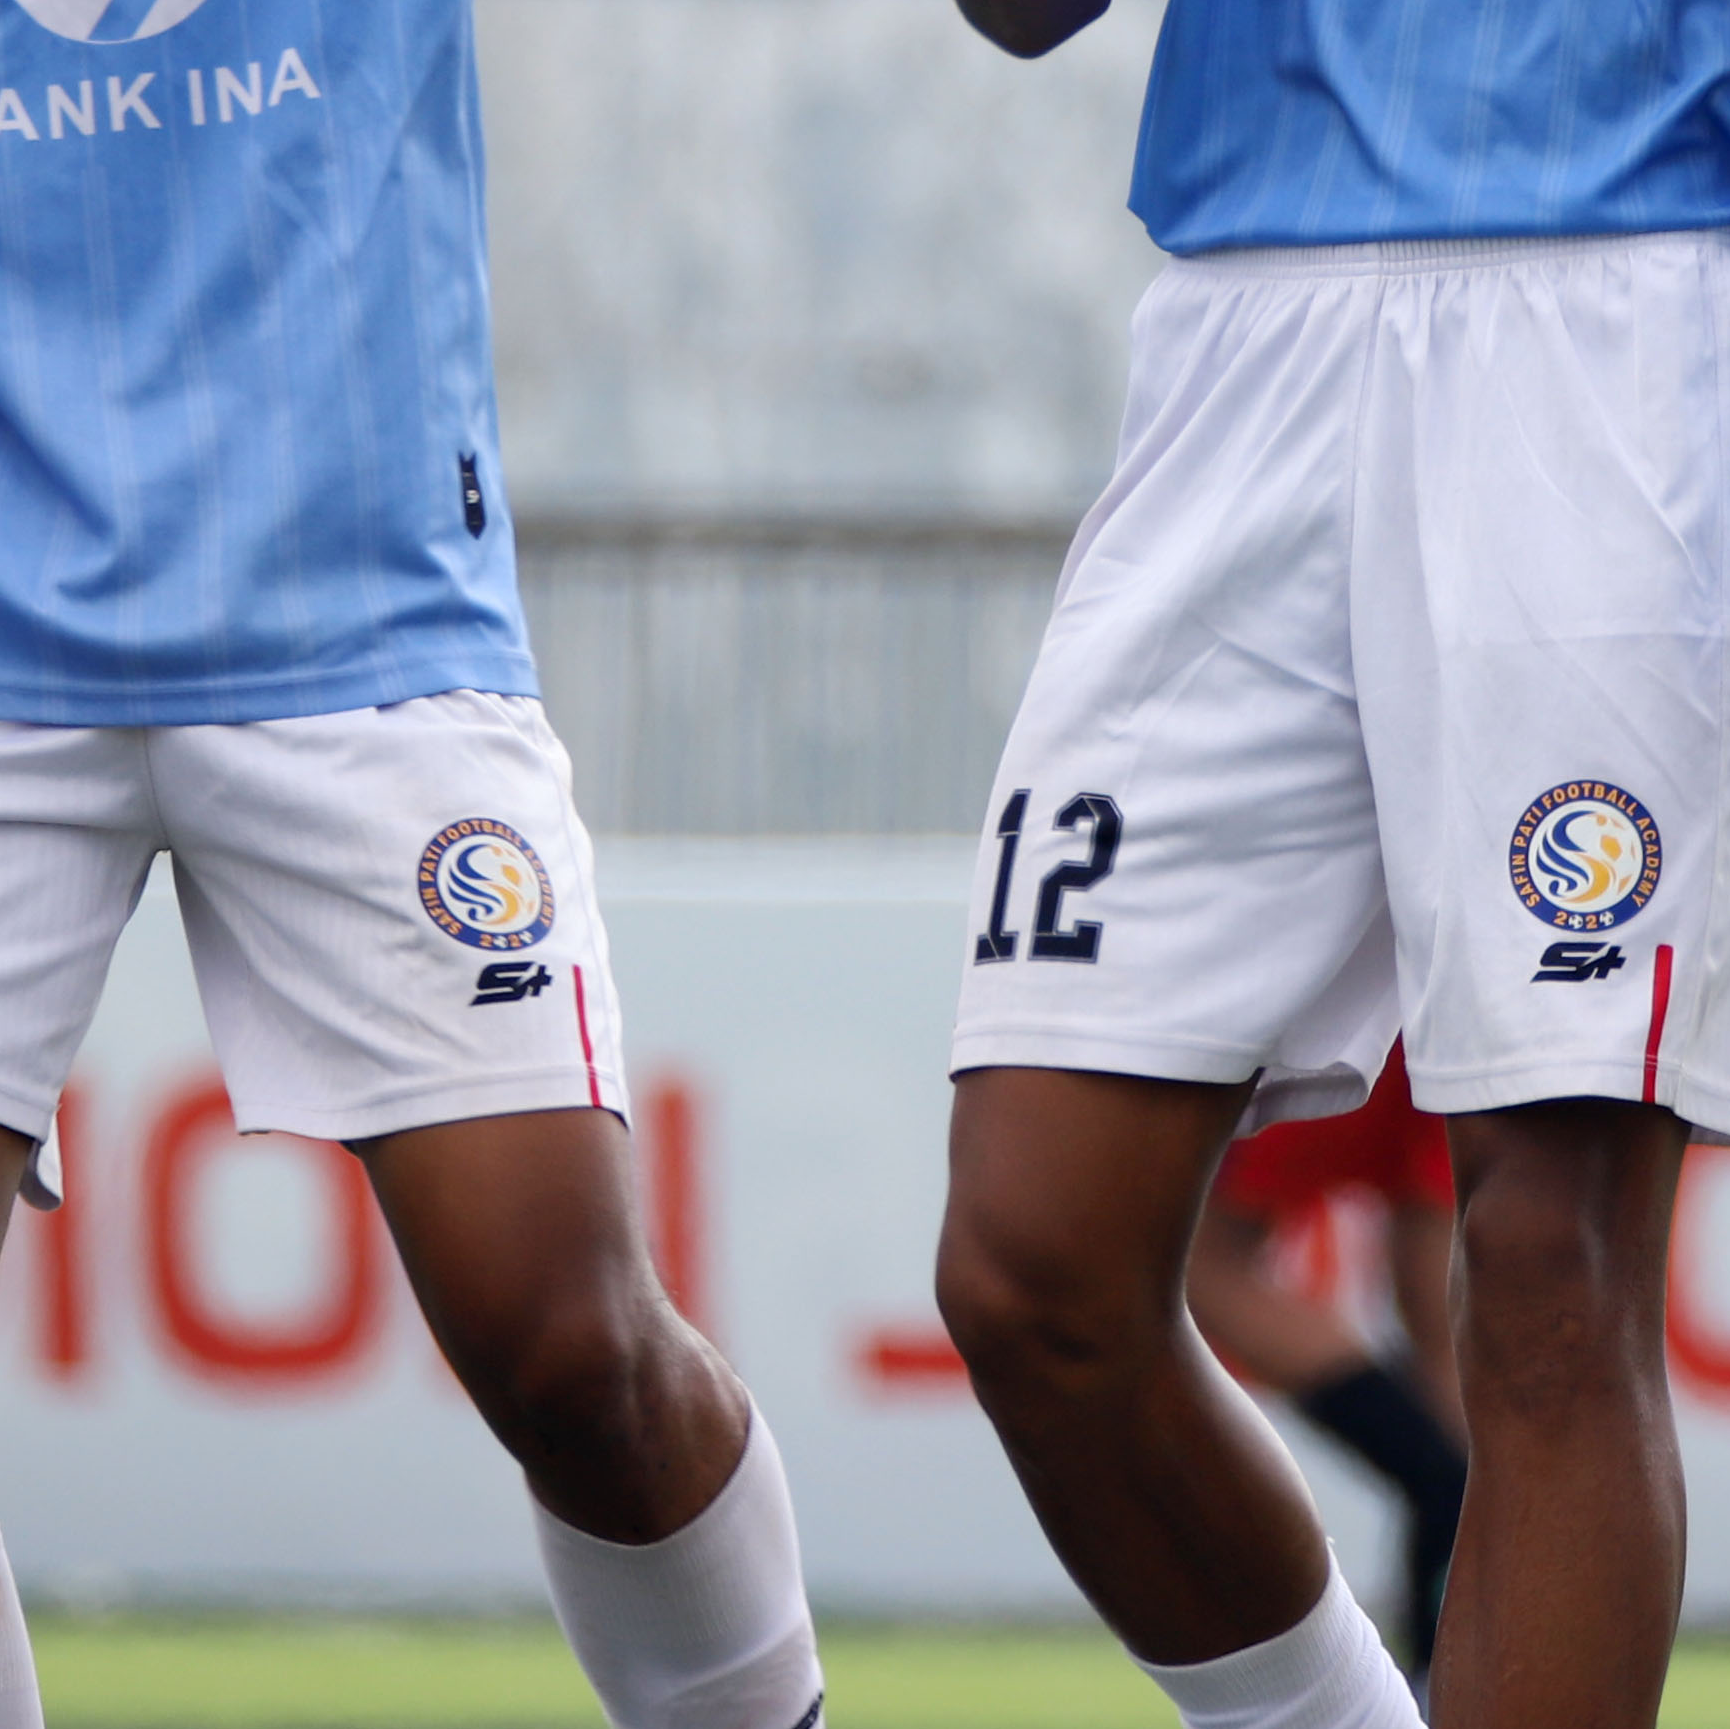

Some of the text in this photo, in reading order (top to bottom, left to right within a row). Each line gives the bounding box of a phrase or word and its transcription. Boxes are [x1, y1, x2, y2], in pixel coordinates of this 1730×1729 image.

[188, 47, 321, 126] INA
[419, 818, 555, 936] SAFIN PATI FOOTBALL ACADEMY
[974, 788, 1124, 965] 12
[1511, 782, 1661, 908] SAFIN PATI FOOTBALL ACADEMY
